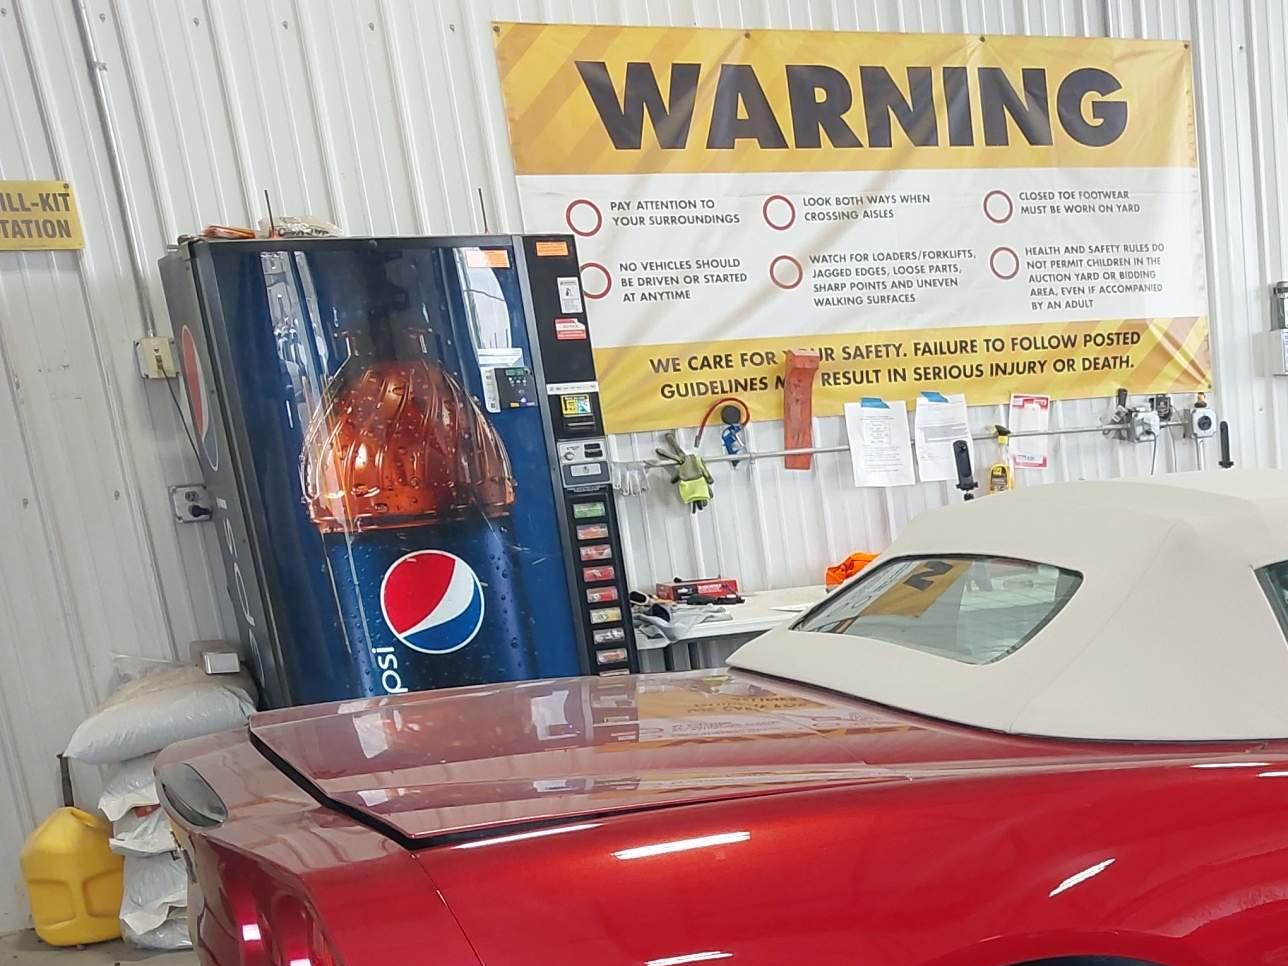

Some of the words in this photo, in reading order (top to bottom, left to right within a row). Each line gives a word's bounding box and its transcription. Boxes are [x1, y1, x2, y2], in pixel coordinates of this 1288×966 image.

[575, 61, 1128, 150] WARNING
[803, 197, 832, 206] LOOK
[835, 196, 863, 206] BOTH
[866, 195, 897, 205] WAYS
[900, 194, 930, 204] WHEN
[1019, 192, 1055, 201] CLOSED
[1058, 191, 1075, 200] TOE
[1079, 191, 1129, 200] FOOTWEAR
[610, 201, 632, 211] PAY
[636, 200, 696, 210] ATTENTION
[700, 199, 715, 209] TO
[1021, 206, 1047, 215] MUST
[1050, 205, 1061, 214] BE
[1064, 204, 1095, 214] WORN
[1099, 204, 1113, 213] ON
[1117, 204, 1140, 212] YARD
[612, 216, 645, 226] YOUR
[650, 214, 740, 225] SURROUNDINGS
[804, 210, 859, 221] CROSSING
[862, 209, 894, 219] AISLES
[809, 254, 847, 264] WATCH
[850, 253, 869, 262] FOR
[872, 249, 976, 262] LOADERS/FORKLIFTS,
[1025, 246, 1060, 256] HEALTH
[1064, 245, 1085, 255] AND
[1088, 244, 1120, 254] SAFETY
[1124, 244, 1150, 253] RULES
[1152, 244, 1165, 252] DO
[620, 263, 637, 272] NO
[640, 260, 691, 271] VEHICLES
[695, 259, 740, 269] SHOULD
[1027, 260, 1047, 270] NOT
[1050, 259, 1083, 268] PERMIT
[1086, 258, 1131, 267] CHILDREN
[1134, 257, 1144, 266] IN
[1146, 257, 1161, 265] THE
[812, 268, 852, 279] JAGGED
[855, 267, 890, 277] EDGES,
[893, 266, 926, 275] LOOSE
[929, 264, 962, 274] PARTS,
[1028, 274, 1072, 283] AUCTION
[1075, 272, 1099, 282] YARD
[1103, 272, 1116, 280] OR
[1119, 270, 1156, 280] BIDDING
[621, 278, 634, 287] BE
[637, 275, 680, 286] DRIVEN
[684, 274, 700, 285] OR
[704, 273, 747, 284] STARTED
[813, 283, 847, 293] SHARP
[850, 281, 887, 291] POINTS
[890, 280, 914, 289] AND
[916, 278, 958, 288] UNEVEN
[623, 292, 636, 302] AT
[640, 290, 691, 301] ANYTIME
[1030, 288, 1058, 297] AREA,
[1061, 286, 1085, 295] EVEN
[1088, 286, 1097, 294] IF
[1099, 283, 1162, 294] ACCOMPANIED
[814, 296, 863, 307] WALKING
[866, 294, 916, 304] SURFACES
[1032, 302, 1043, 310] BY
[1046, 301, 1061, 310] AN
[1064, 300, 1094, 309] ADULT
[650, 357, 681, 374] WE
[688, 354, 734, 371] CARE
[740, 351, 778, 367] FOR
[842, 343, 907, 360] SAFETY.
[914, 340, 978, 357] FAILURE
[983, 338, 1005, 352] TO
[1012, 334, 1078, 351] FOLLOW
[1084, 331, 1141, 348] POSTED
[660, 376, 768, 399] GUIDELINES
[822, 369, 881, 387] RESULT
[888, 368, 907, 383] IN
[914, 364, 984, 382] SERIOUS
[990, 360, 1048, 377] INJURY
[1053, 358, 1076, 373] OR
[1082, 355, 1134, 371] DEATH.
